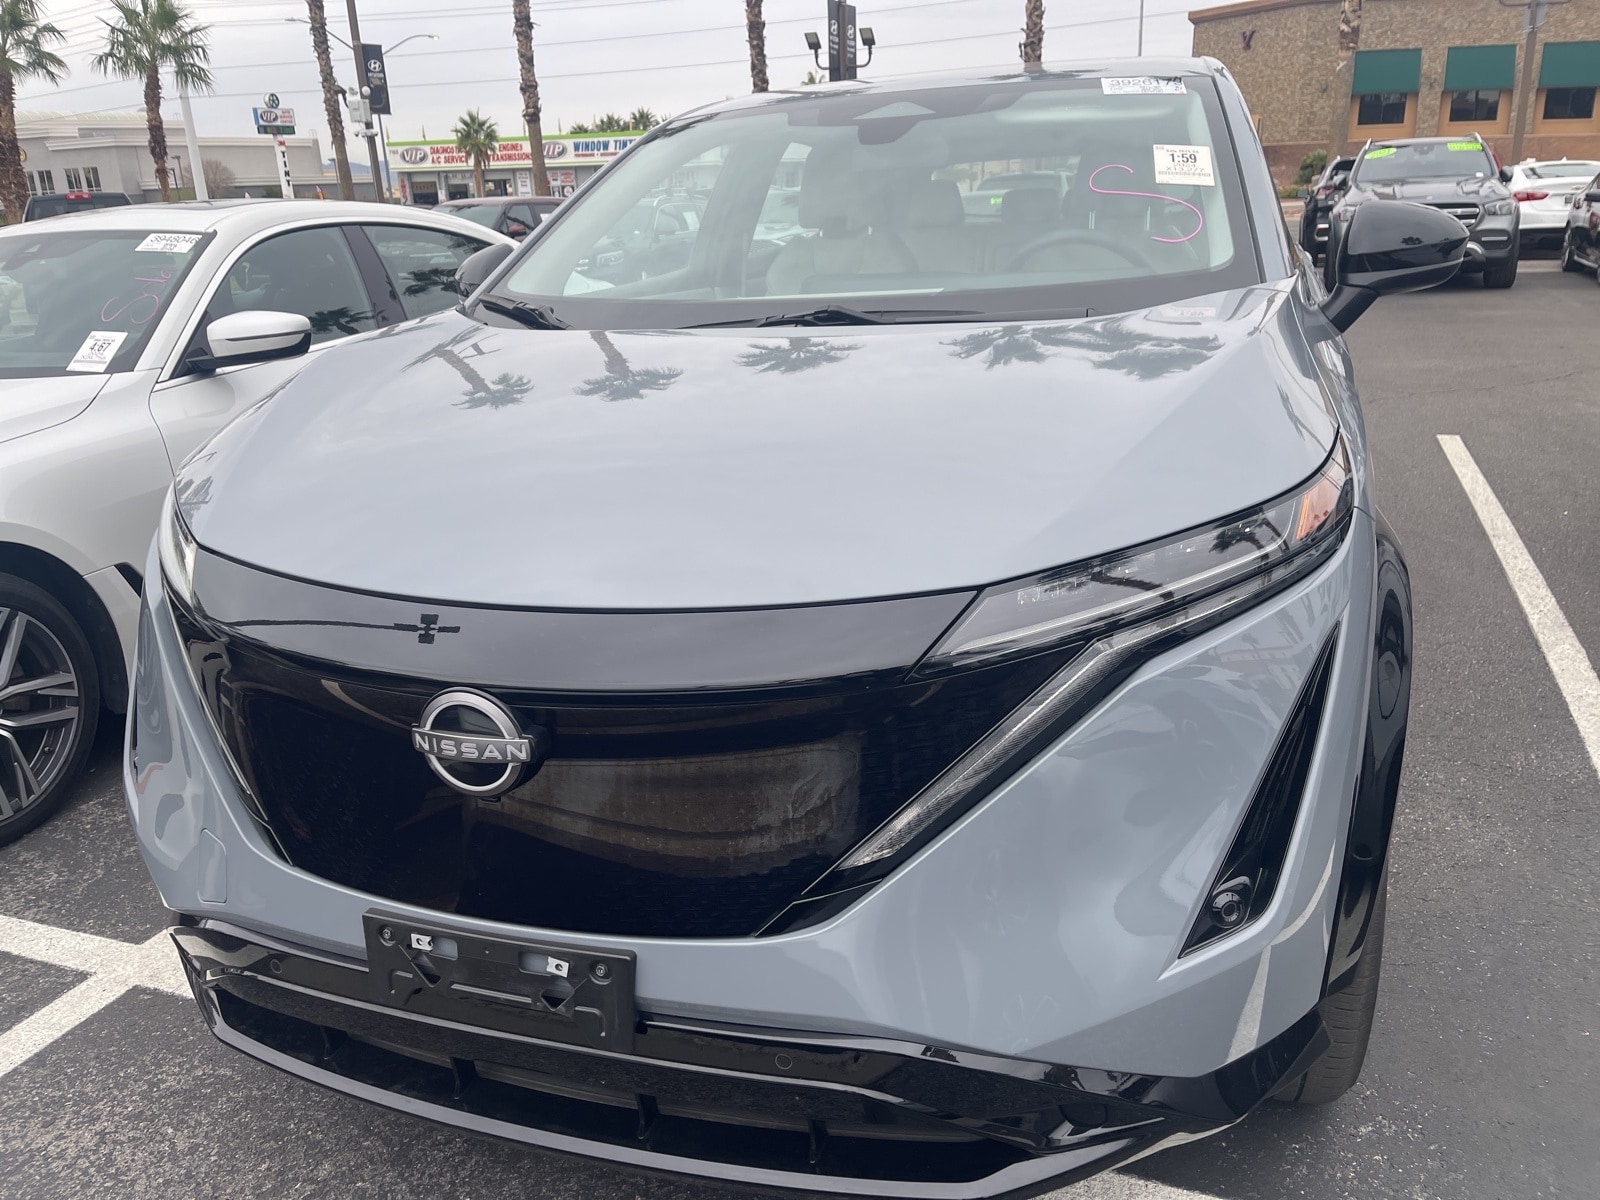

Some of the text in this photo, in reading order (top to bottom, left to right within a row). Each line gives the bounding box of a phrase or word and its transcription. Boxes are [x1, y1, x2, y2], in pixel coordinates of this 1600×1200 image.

[573, 139, 610, 152] WINDOW
[402, 150, 425, 161] VIP
[1168, 153, 1197, 164] 1:59
[1089, 164, 1202, 243] S
[89, 342, 112, 352] 4:67
[414, 732, 527, 760] NISSAN
